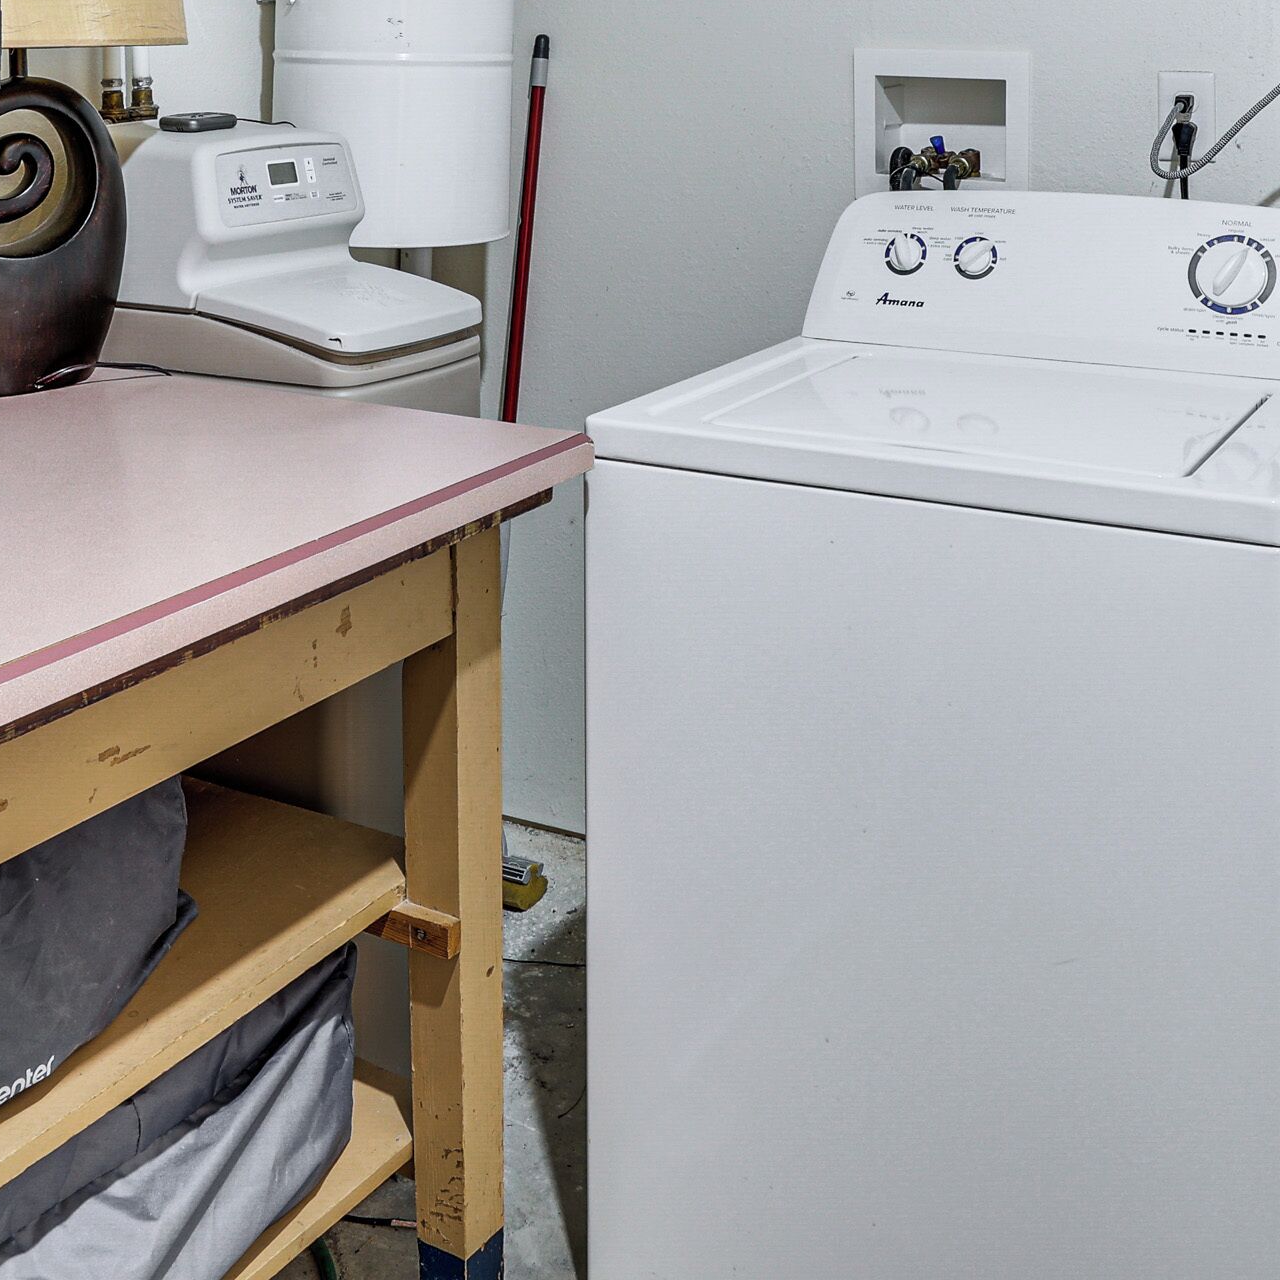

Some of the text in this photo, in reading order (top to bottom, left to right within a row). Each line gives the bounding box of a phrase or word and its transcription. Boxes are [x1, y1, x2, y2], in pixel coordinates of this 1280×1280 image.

[230, 184, 257, 196] MORTON
[228, 194, 263, 204] SYSTEM SAVER
[950, 206, 1016, 215] WASH TEMPERATURE
[1221, 219, 1252, 227] NORMAL
[875, 291, 925, 308] Amana
